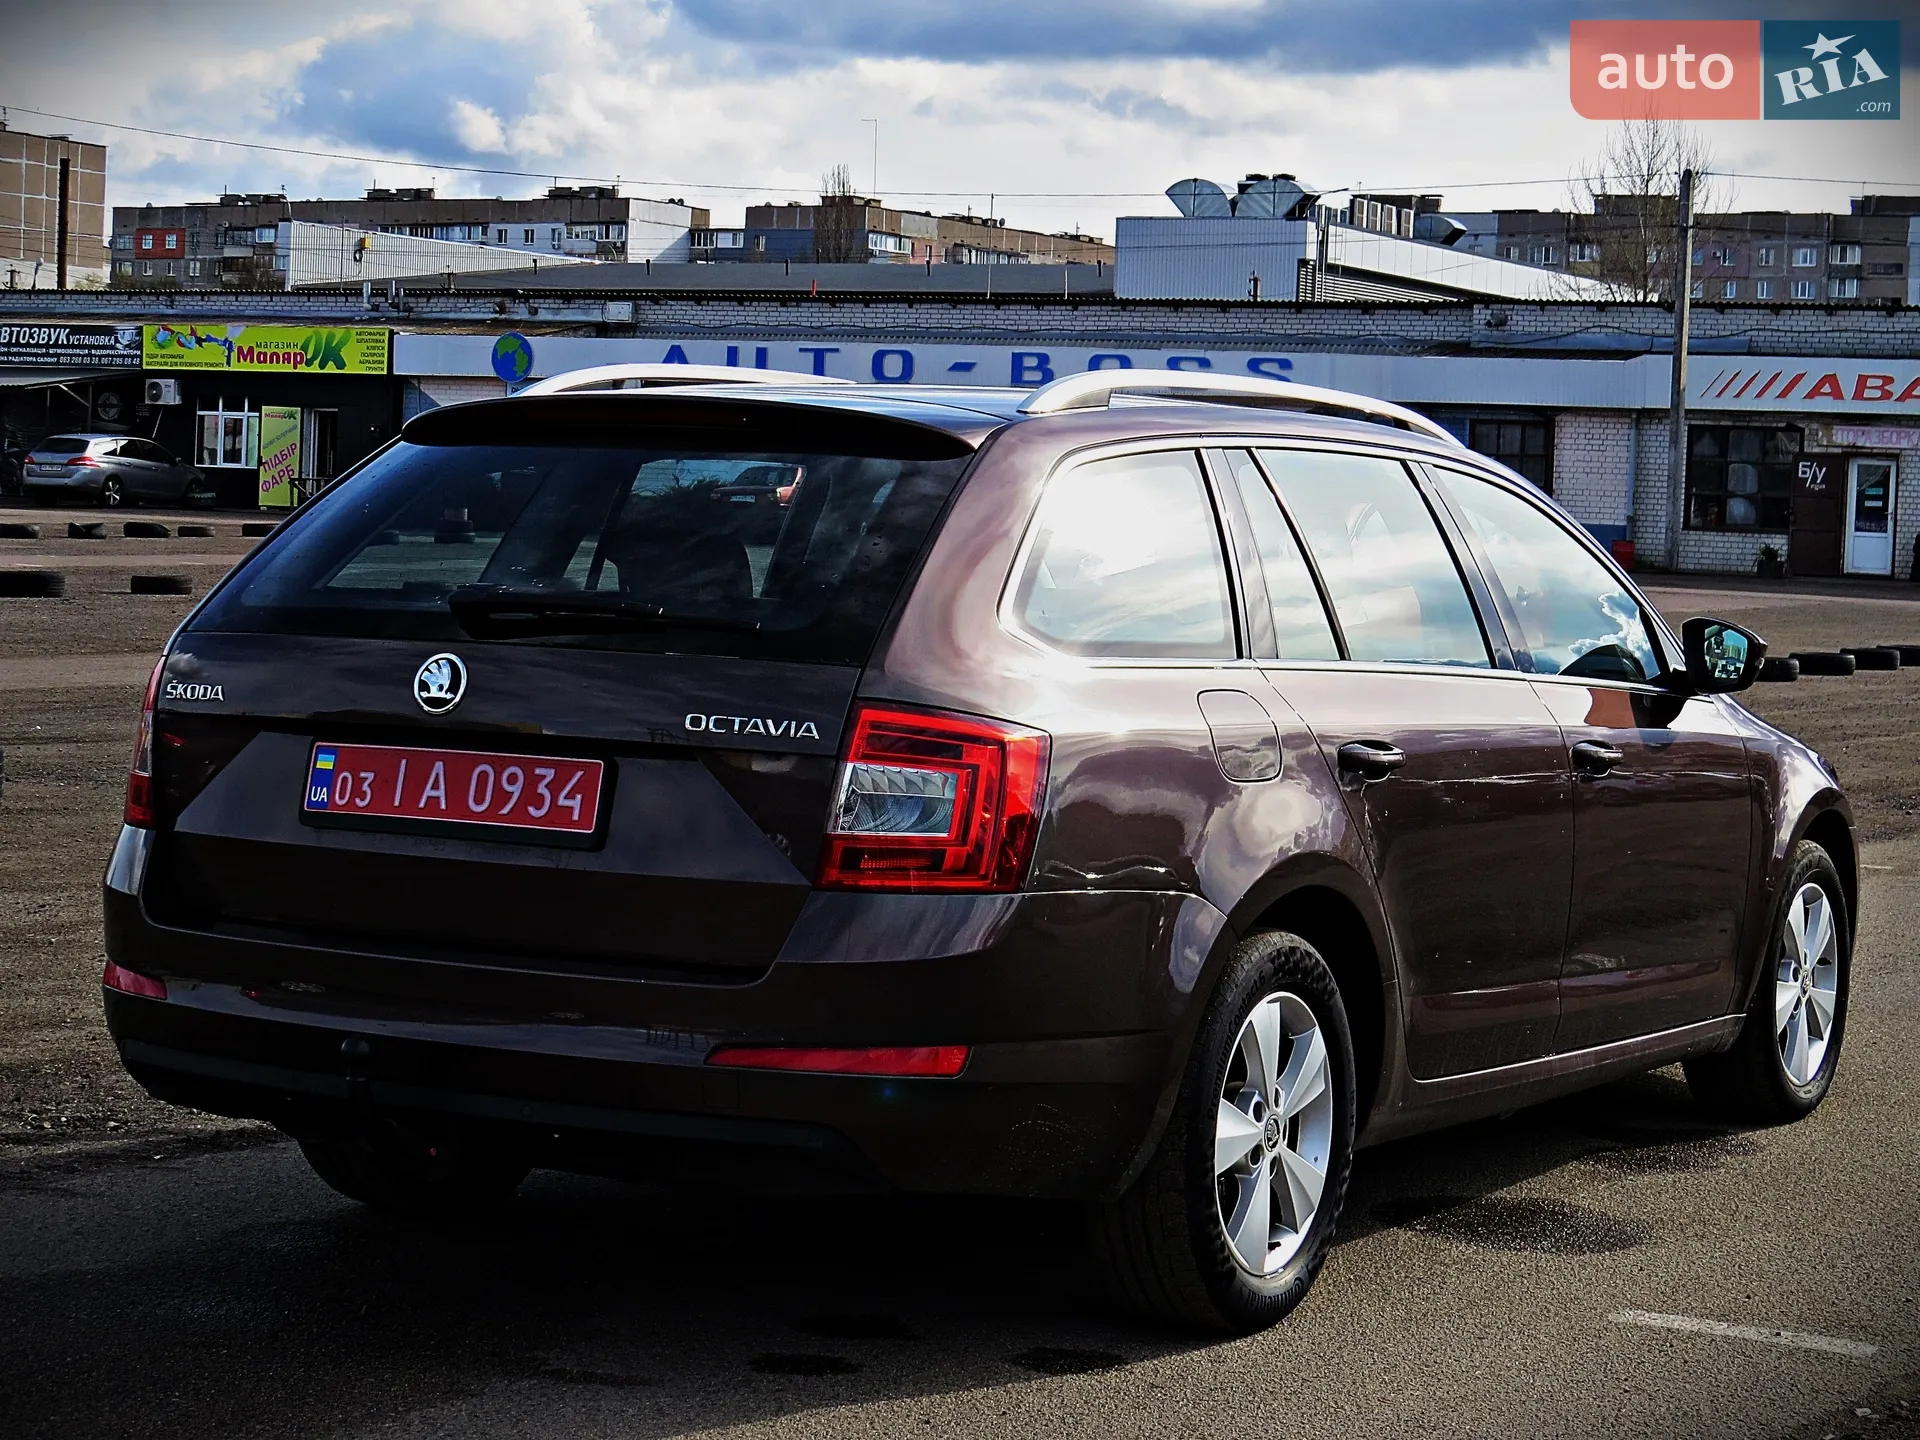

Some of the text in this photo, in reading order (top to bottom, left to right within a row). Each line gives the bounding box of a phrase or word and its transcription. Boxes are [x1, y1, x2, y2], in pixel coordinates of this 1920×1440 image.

[0, 327, 115, 346] ВТОЗВУК УСТАНОВКА
[255, 341, 299, 350] магазин
[237, 345, 305, 370] Маляр
[261, 442, 298, 473] ПІДБІР
[261, 464, 296, 493] ФАРБ
[165, 679, 225, 702] ŠKODA
[684, 713, 820, 740] OCTAVIA
[310, 786, 328, 803] UA
[334, 770, 376, 808] 03
[466, 763, 585, 822] 0934
